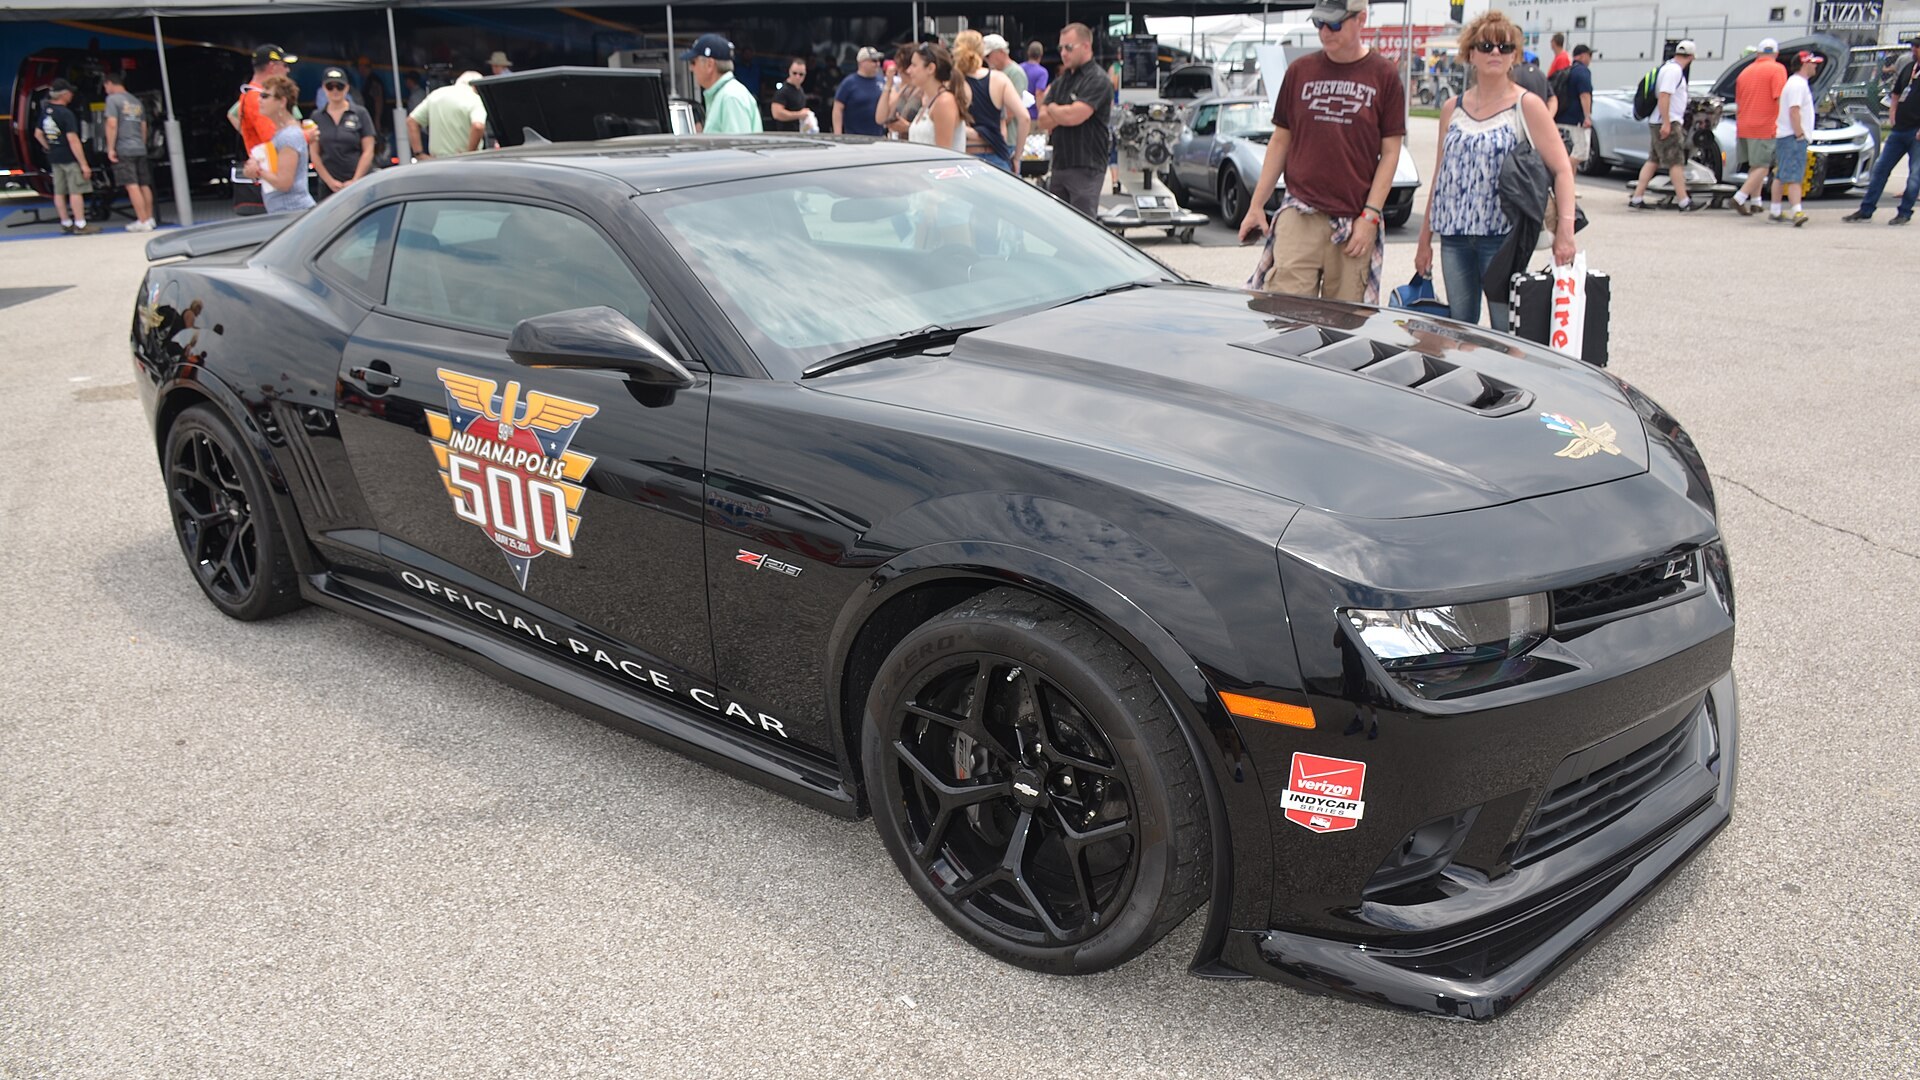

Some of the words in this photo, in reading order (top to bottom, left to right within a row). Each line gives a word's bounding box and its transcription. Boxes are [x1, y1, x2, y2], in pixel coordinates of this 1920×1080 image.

[1819, 1, 1881, 23] FUZZY'S
[1301, 80, 1377, 107] CHEVROLET
[449, 430, 566, 480] INDIANAPOLIS
[448, 454, 572, 556] 500
[401, 571, 558, 645] OFFICIAL
[568, 638, 674, 693] PACE
[690, 688, 788, 738] CAR
[1297, 779, 1353, 797] verizon
[1289, 793, 1358, 811] INDYCAR
[1300, 804, 1345, 816] SERIES
